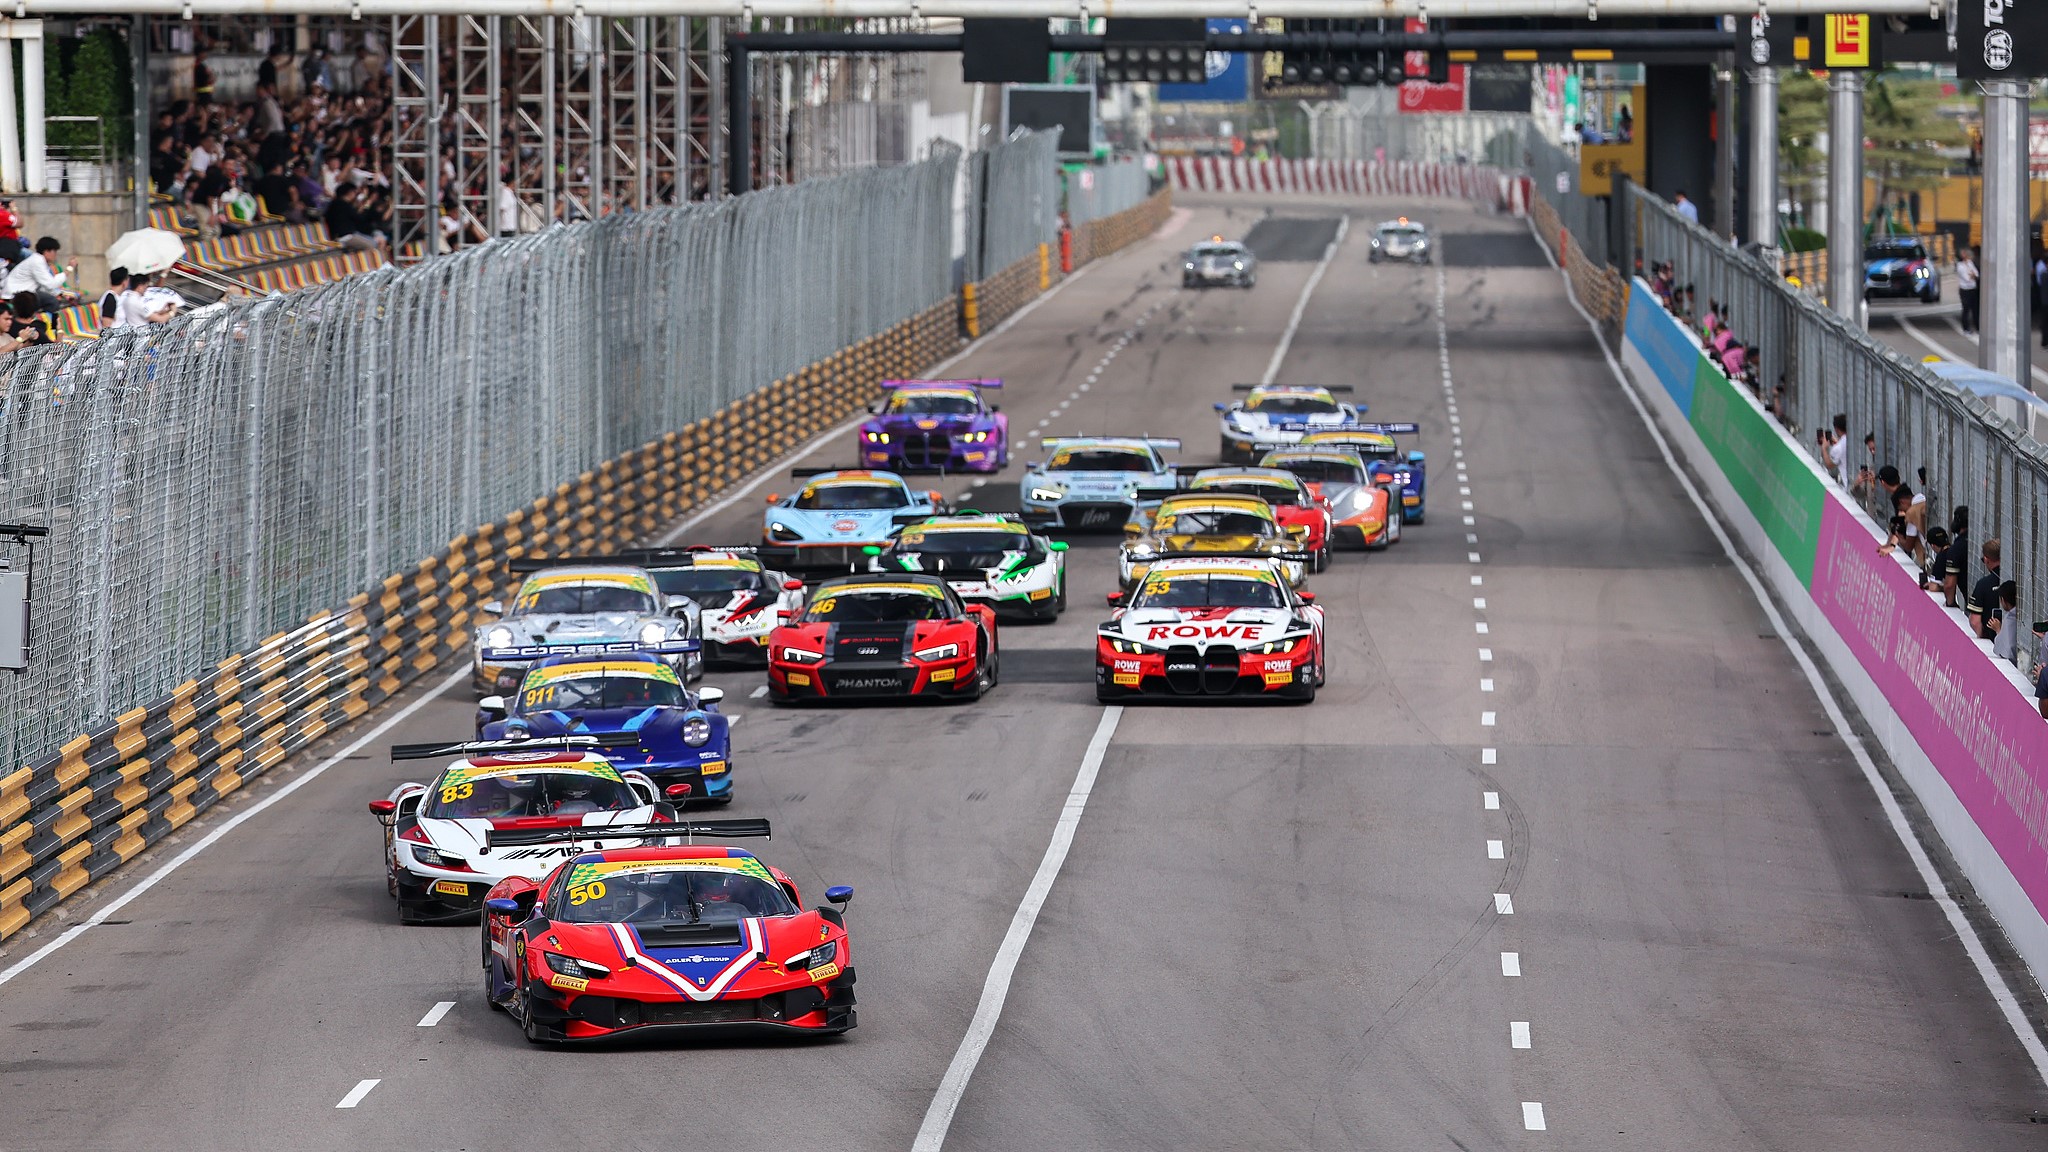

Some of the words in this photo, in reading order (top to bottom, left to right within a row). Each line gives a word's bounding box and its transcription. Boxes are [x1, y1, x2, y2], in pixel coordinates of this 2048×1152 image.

[1145, 582, 1171, 595] 53
[809, 598, 837, 614] 46
[1147, 626, 1263, 640] ROWE
[491, 641, 690, 656] PORSCHE
[1114, 660, 1141, 669] ROWE
[1264, 660, 1292, 671] ROWE
[836, 678, 903, 689] PHANTOM
[525, 686, 555, 707] 911
[441, 783, 473, 804] 83
[438, 883, 466, 893] PIRELLI
[570, 881, 607, 906] 50
[812, 965, 837, 979] PIRELLI
[554, 975, 585, 989] PIRELLI
